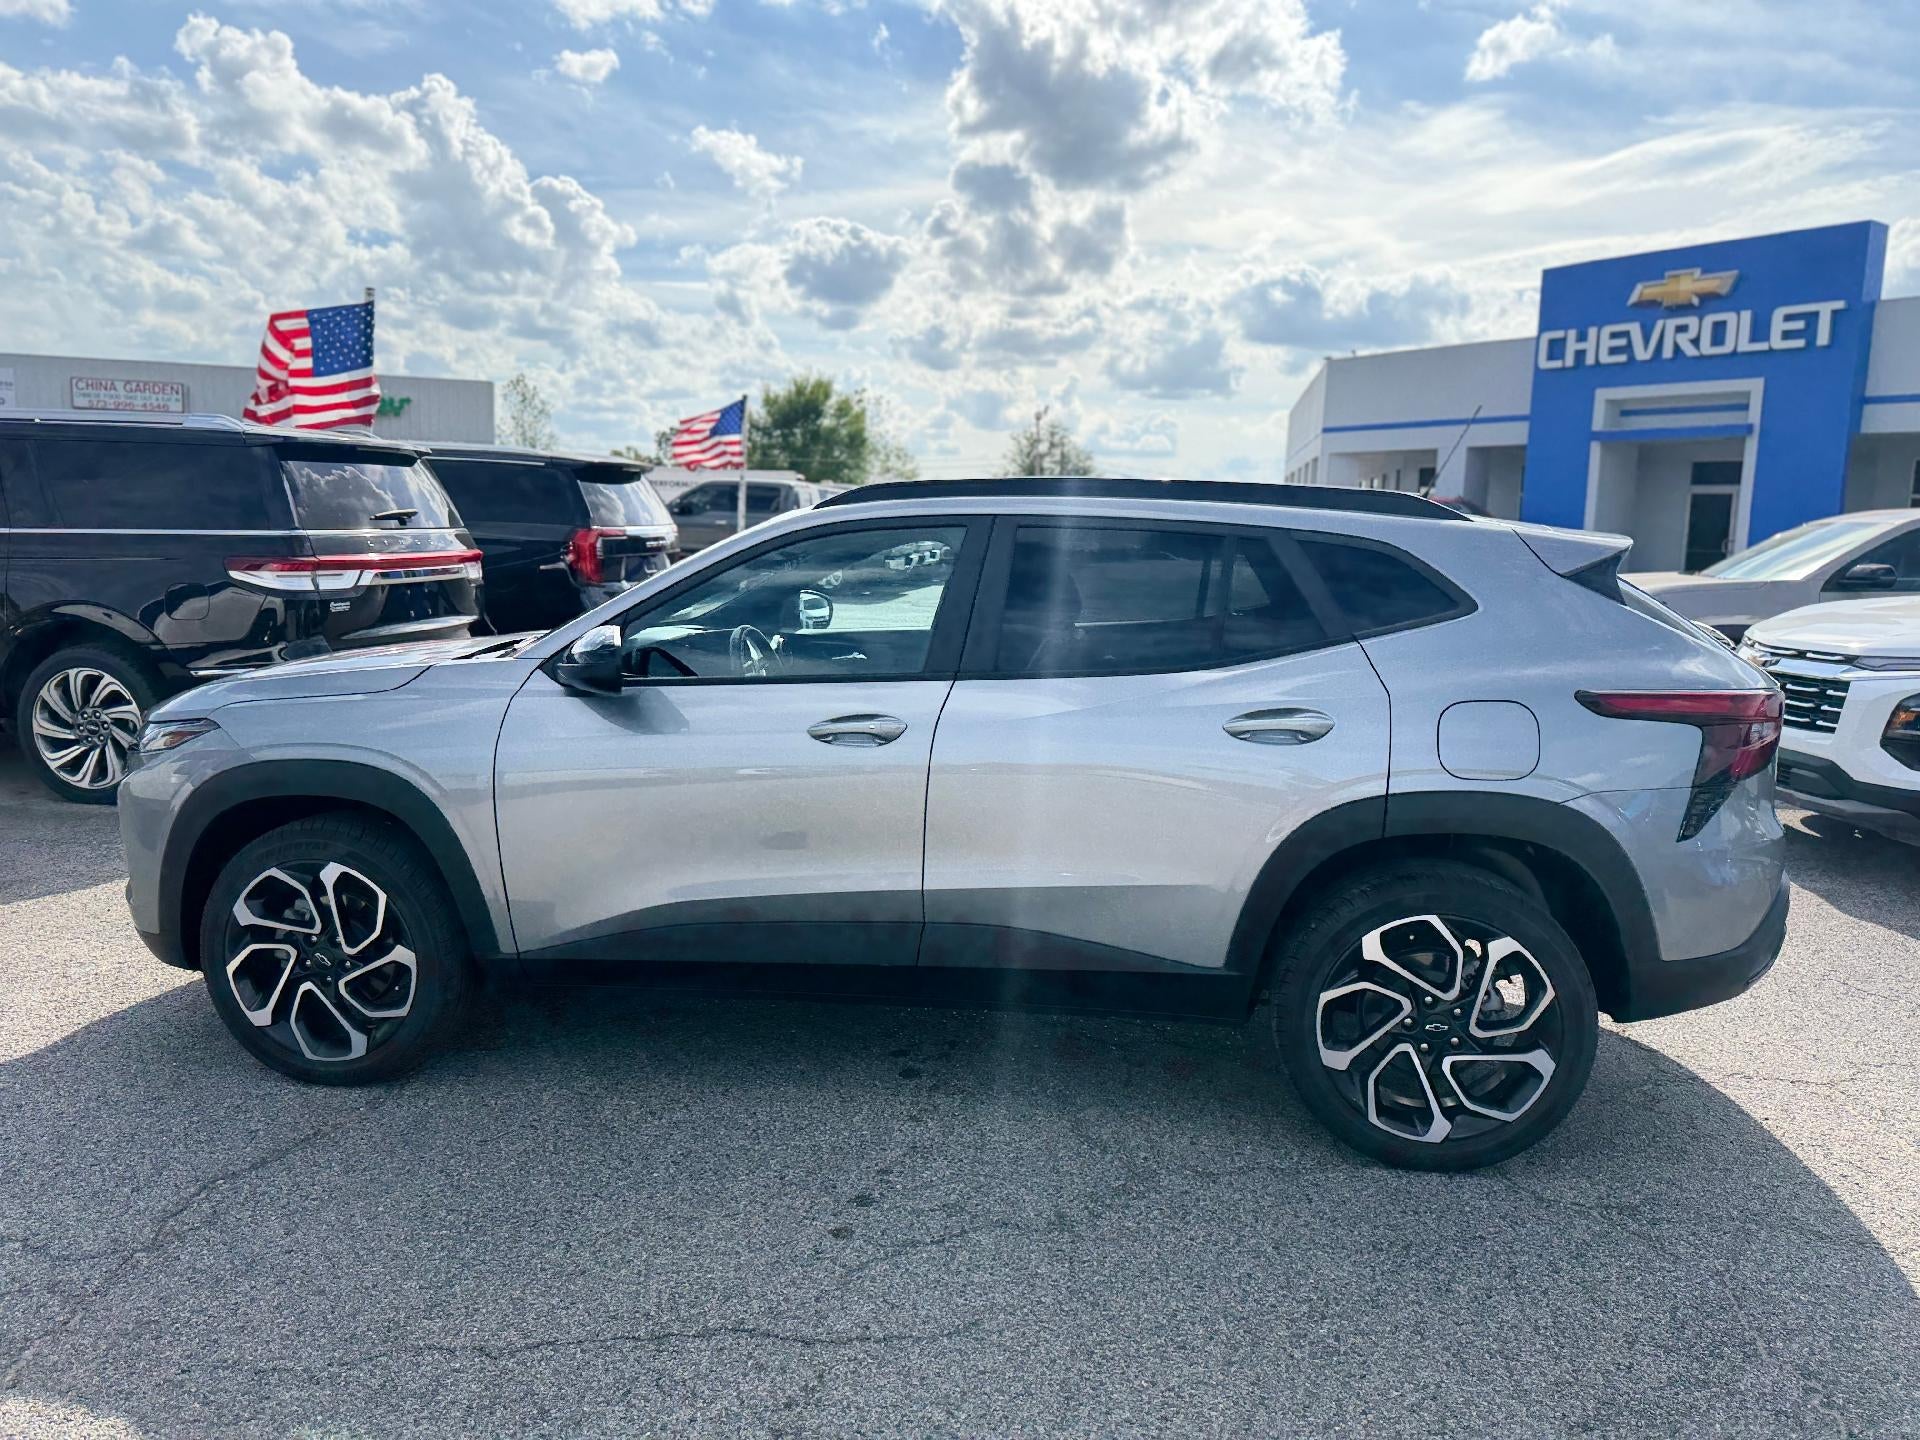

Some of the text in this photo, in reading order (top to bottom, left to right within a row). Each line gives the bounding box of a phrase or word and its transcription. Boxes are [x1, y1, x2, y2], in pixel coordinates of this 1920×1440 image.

[1537, 300, 1846, 369] CHEVROLET
[75, 378, 180, 395] CHINA GARDEN
